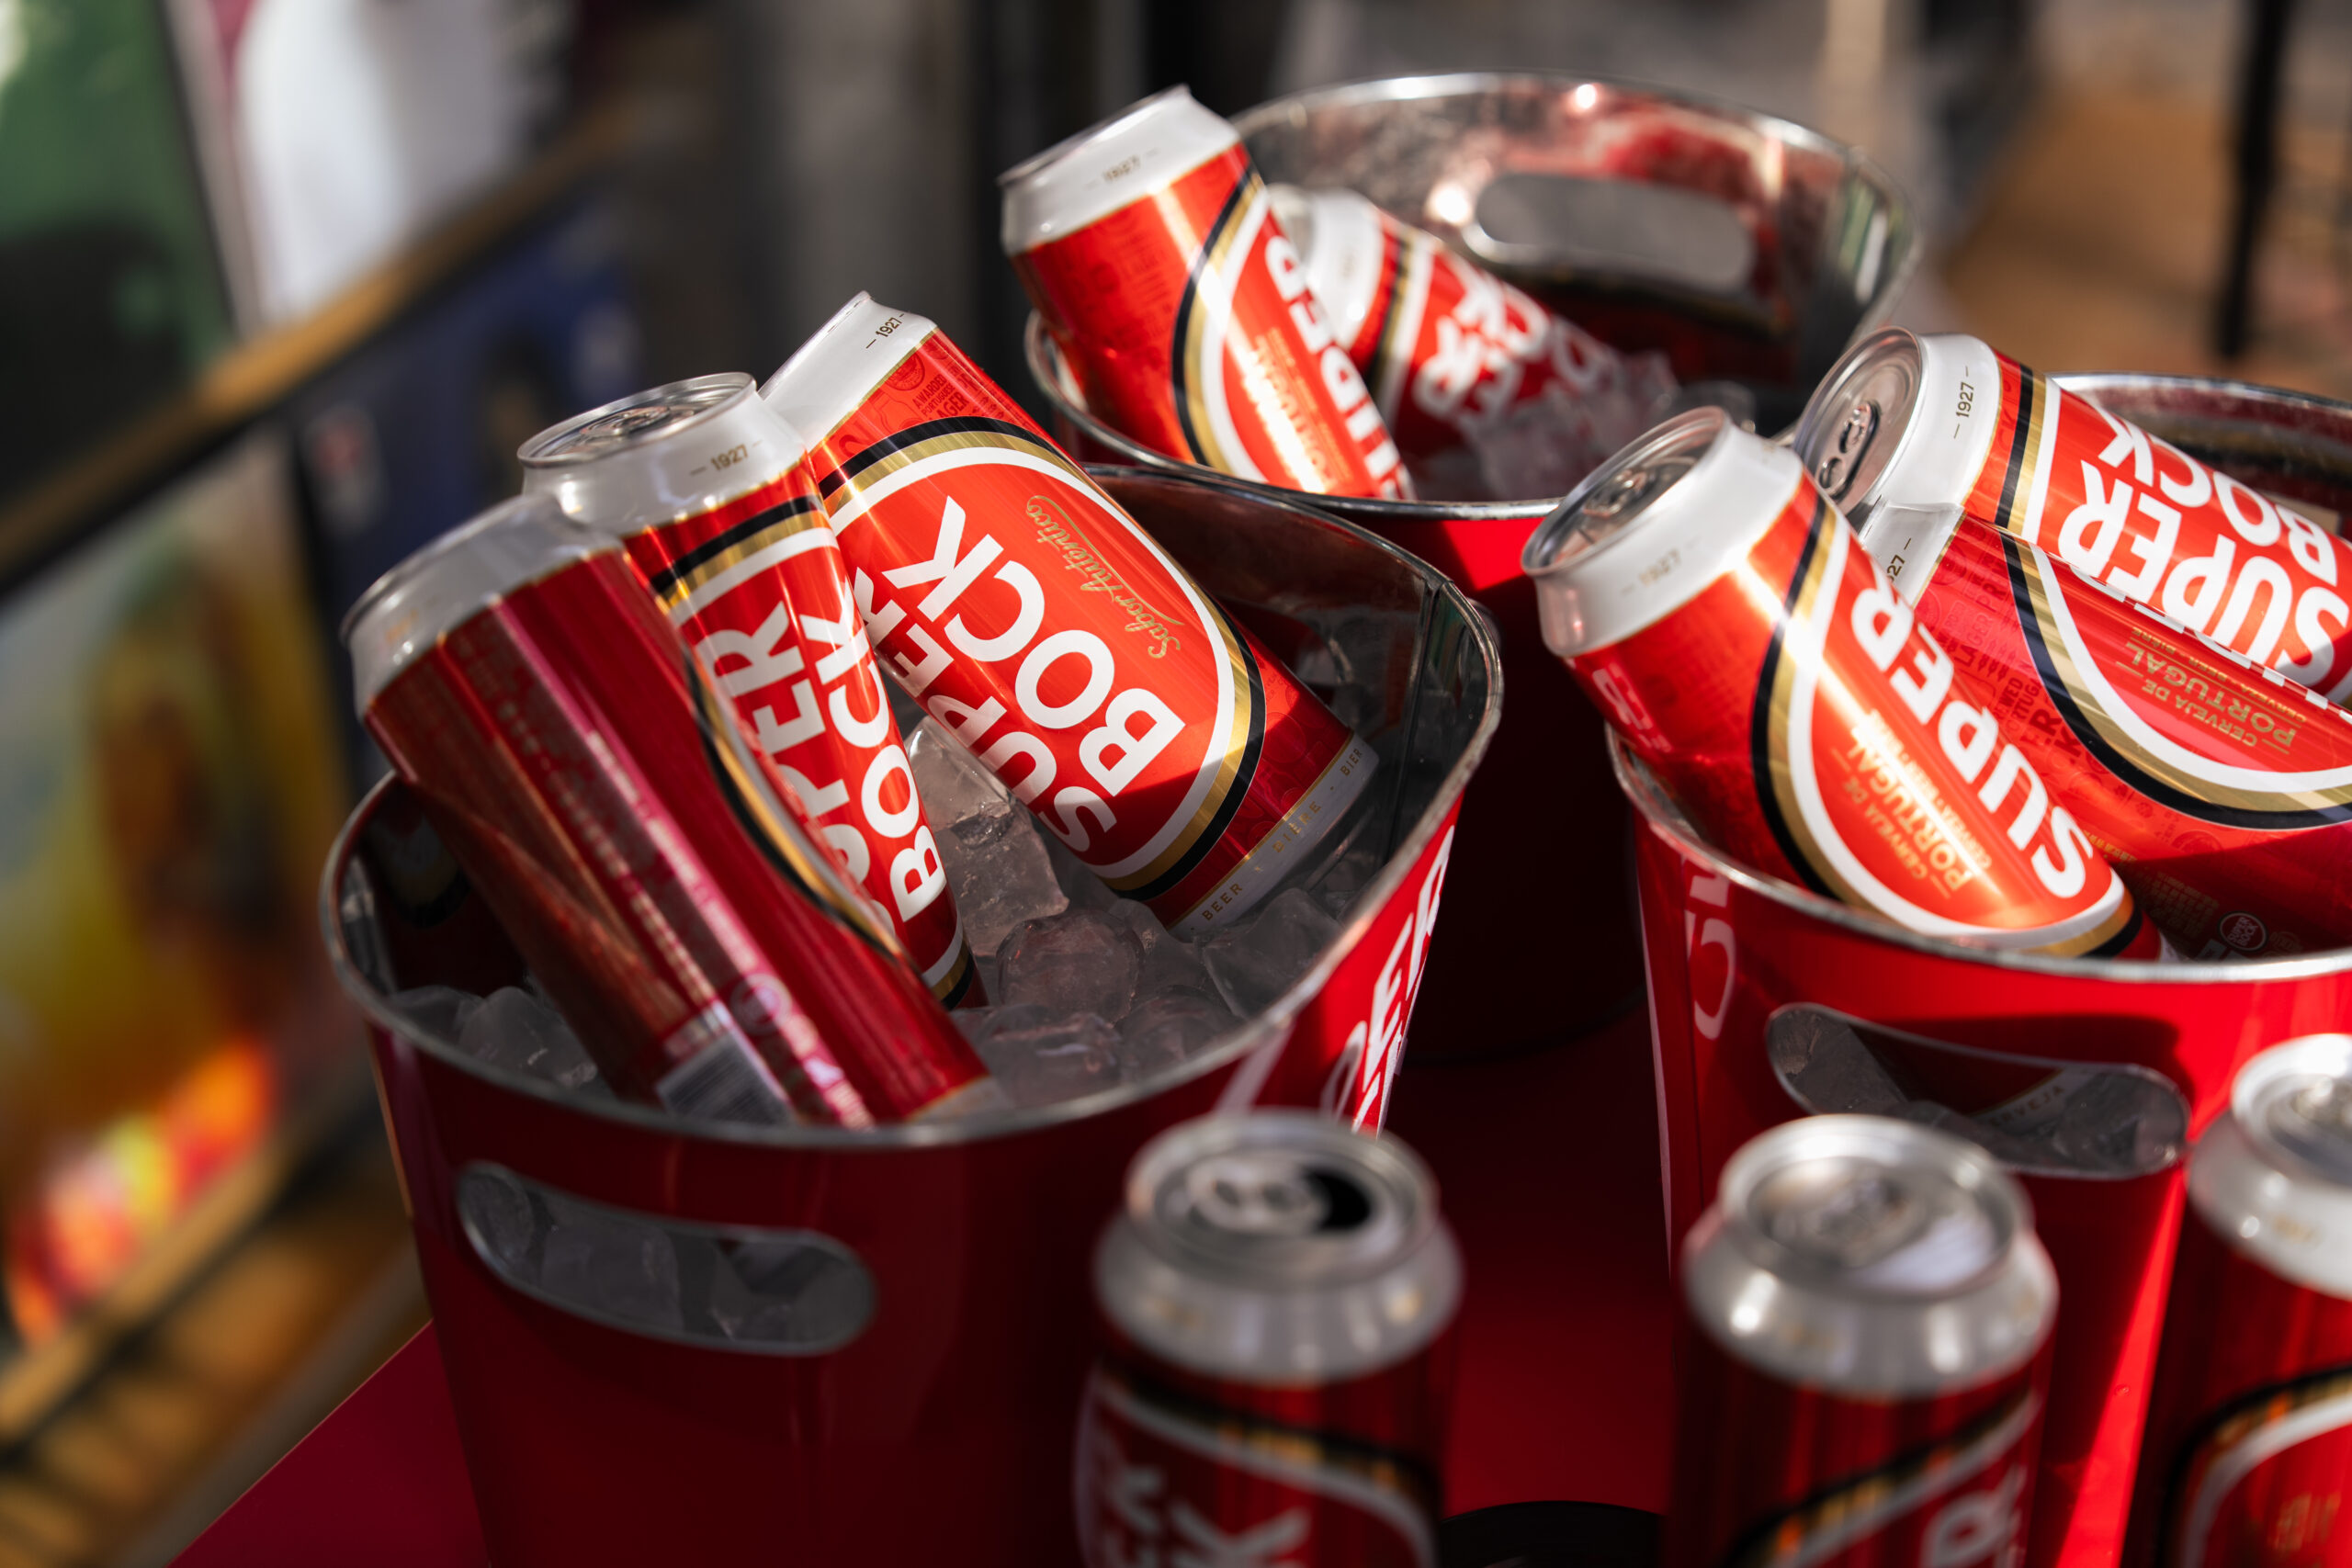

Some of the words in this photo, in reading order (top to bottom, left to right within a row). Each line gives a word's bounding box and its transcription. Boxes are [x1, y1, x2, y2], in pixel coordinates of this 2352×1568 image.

[875, 317, 902, 337] 1927
[912, 374, 947, 409] AWARDED
[921, 383, 956, 415] PORTUGUESE
[929, 391, 970, 420] AGER
[1955, 382, 1974, 418] 1927
[710, 444, 748, 471] 1927
[2086, 402, 2338, 587] BOCK
[1886, 554, 1905, 581] 27
[2057, 459, 2350, 687] SUPER
[881, 495, 1187, 797] BOCK
[1114, 595, 1182, 659] Sabor
[2142, 679, 2171, 702] DE
[2188, 656, 2228, 682] BEER
[2126, 641, 2297, 747] PORTUGAL
[1850, 556, 2094, 898] SUPER
[2175, 694, 2257, 747] CERVEJA
[798, 582, 947, 923] BOCK
[1201, 883, 1243, 921] BEER
[1340, 748, 1363, 777] BIER
